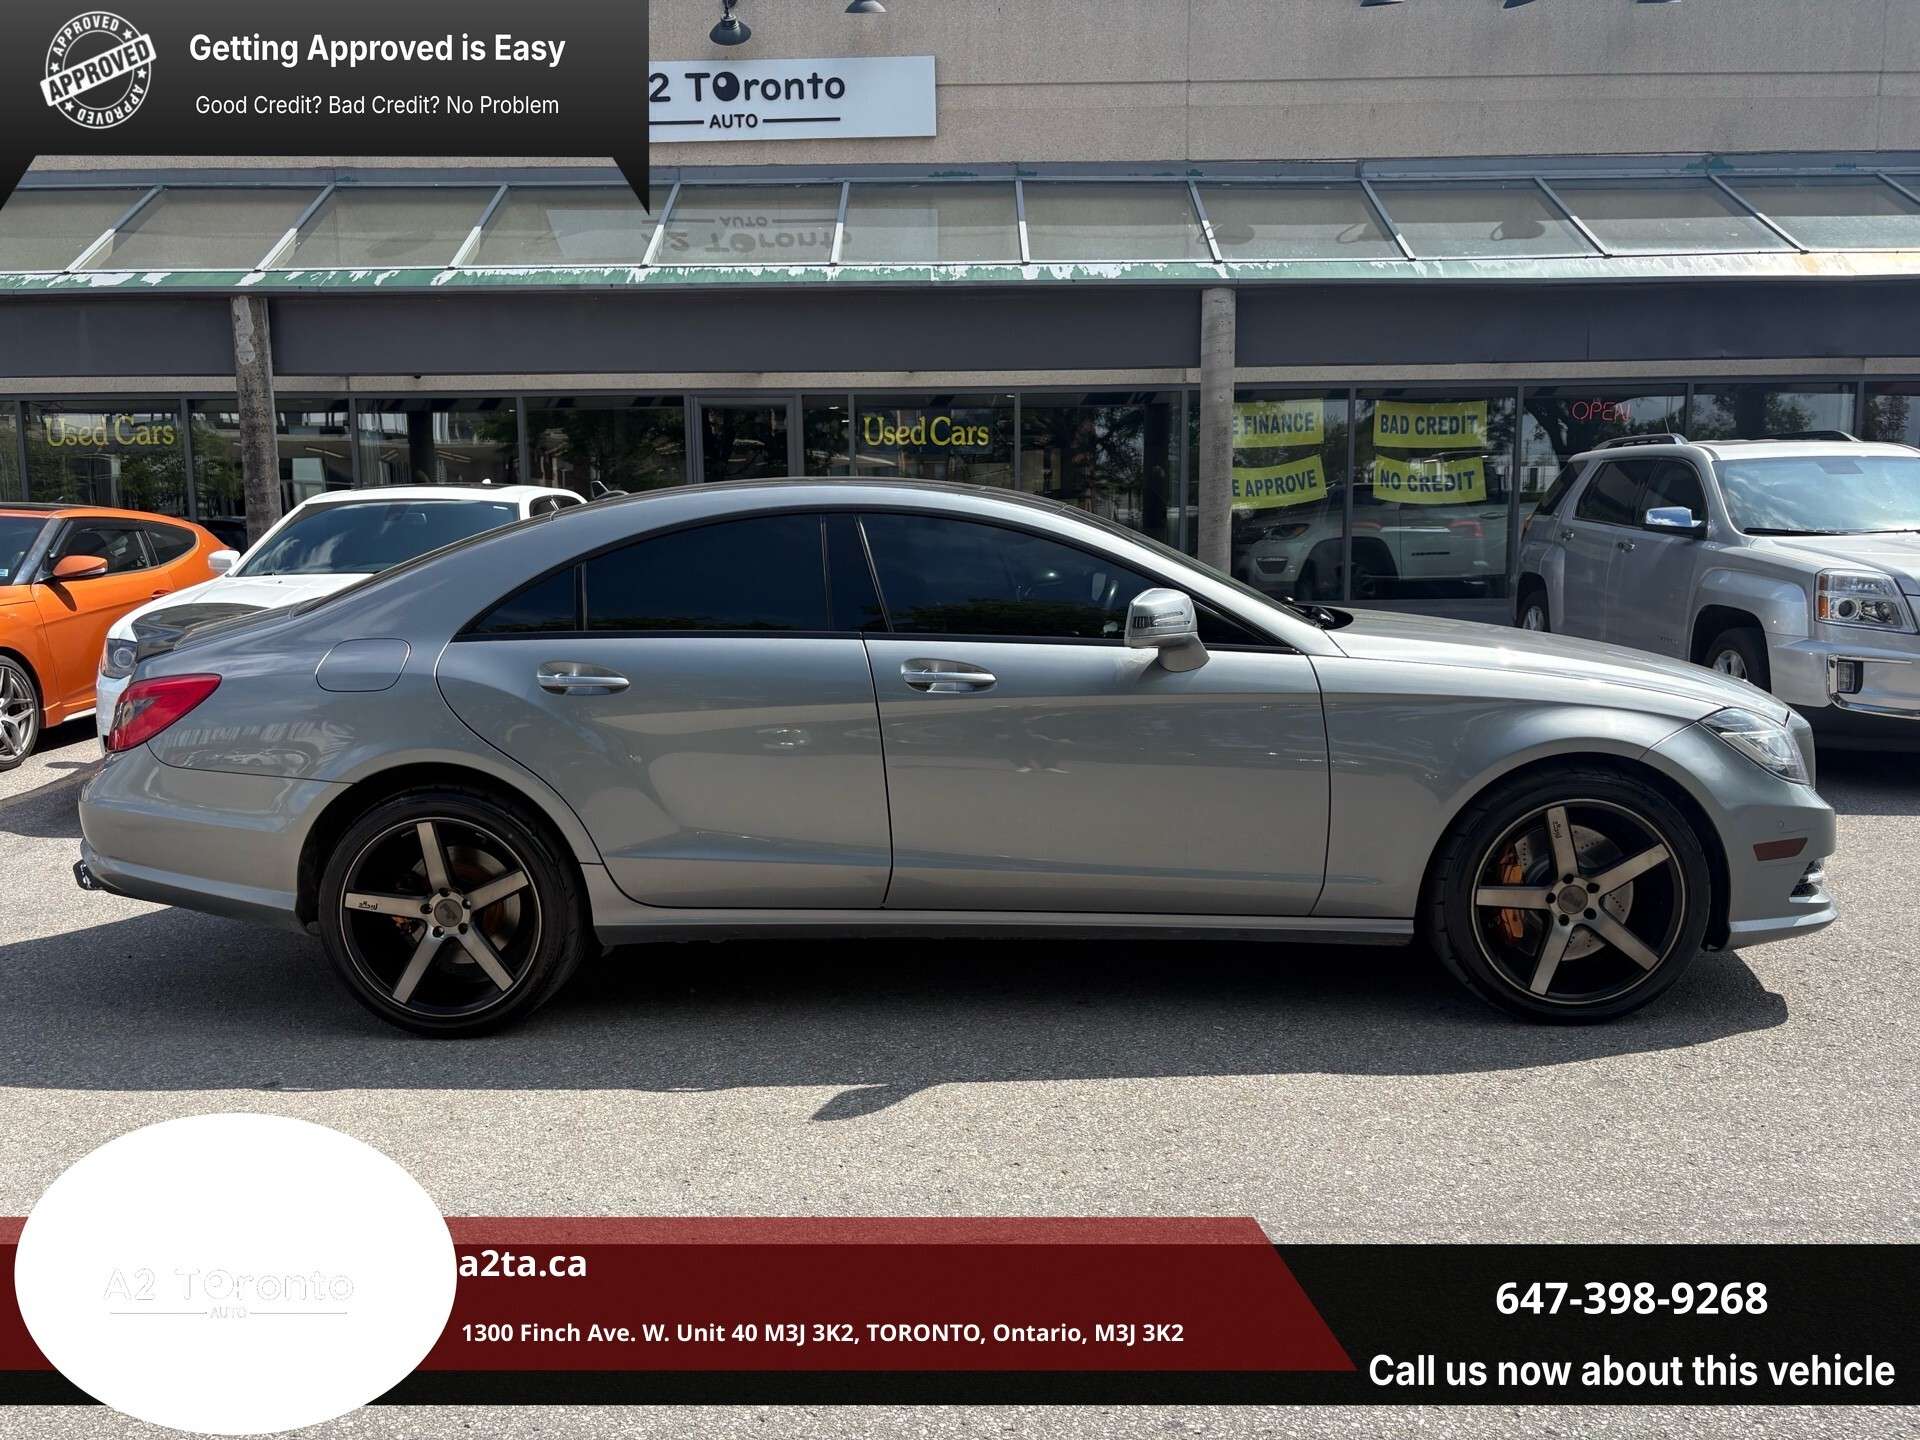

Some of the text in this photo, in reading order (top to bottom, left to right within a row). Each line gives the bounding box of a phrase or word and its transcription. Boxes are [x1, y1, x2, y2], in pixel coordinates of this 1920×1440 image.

[649, 72, 671, 102] 2
[709, 113, 758, 129] AUTO
[1243, 411, 1315, 435] FINANCE
[1571, 401, 1632, 423] OPEN
[44, 415, 175, 447] Used Cars
[863, 416, 989, 446] Used Cars
[1380, 414, 1478, 436] BAD CREDIT
[1232, 468, 1318, 497] E APPROVE
[1380, 469, 1475, 493] NO CREDIT
